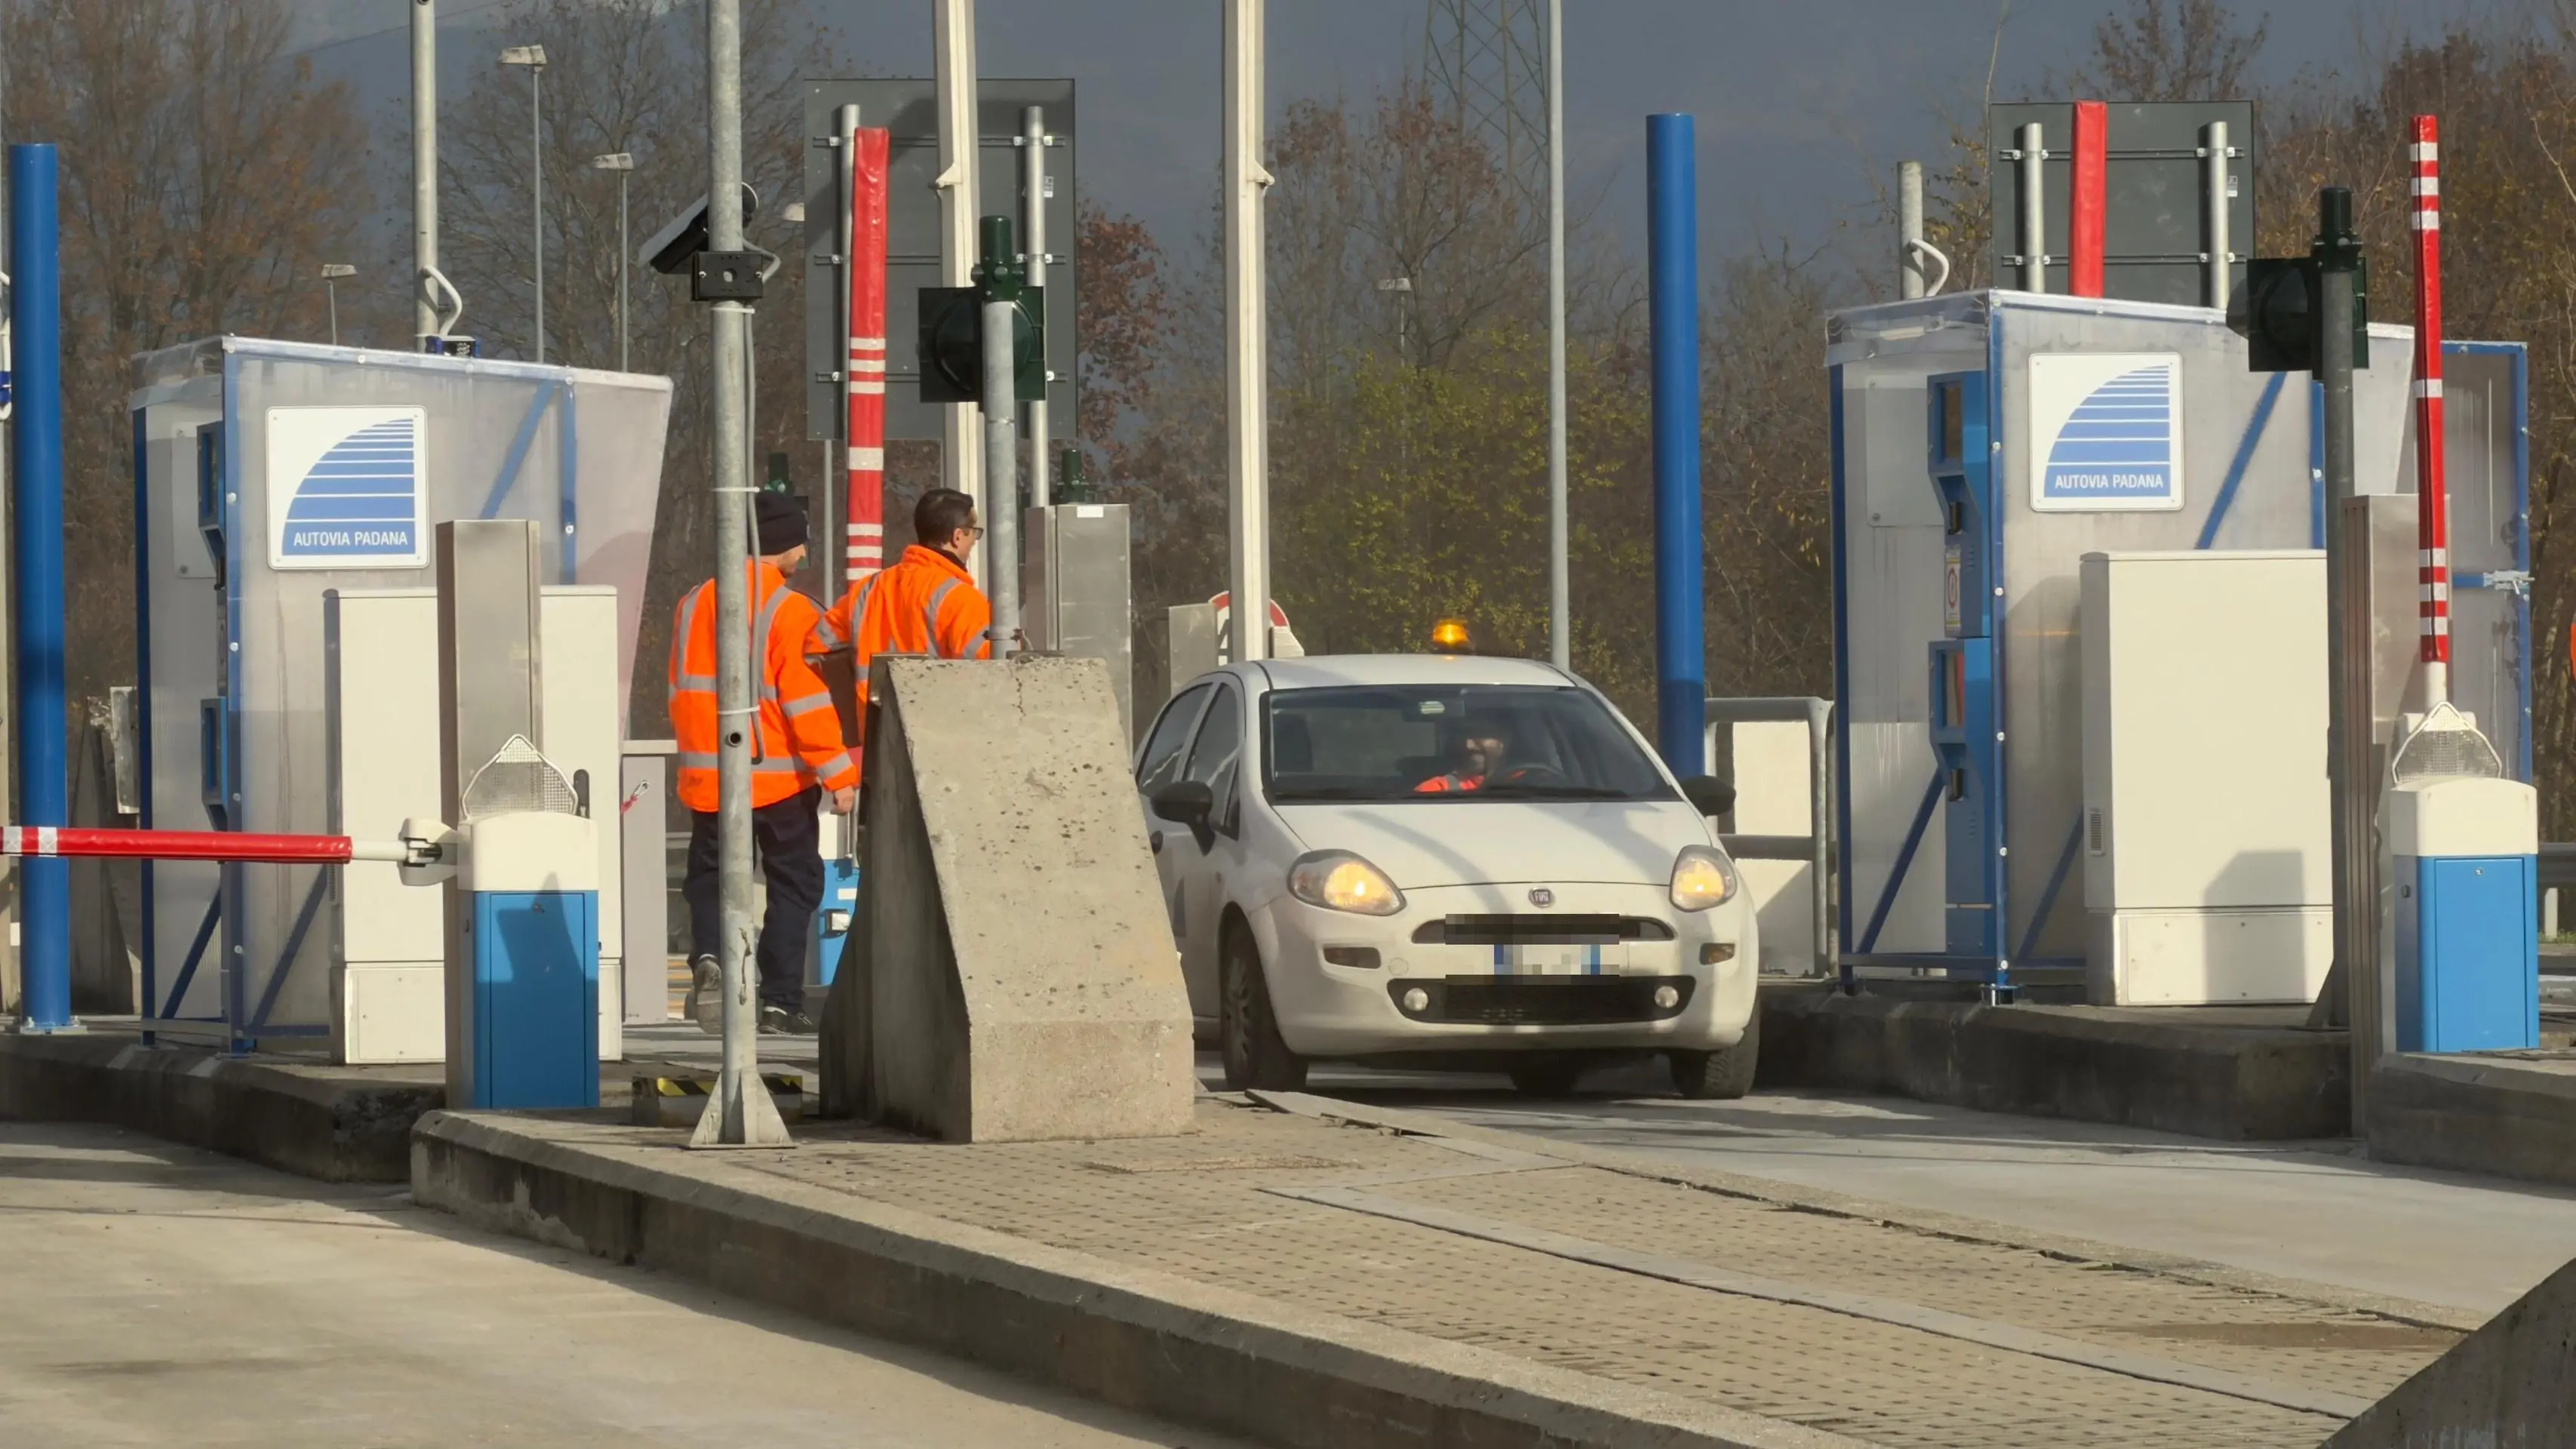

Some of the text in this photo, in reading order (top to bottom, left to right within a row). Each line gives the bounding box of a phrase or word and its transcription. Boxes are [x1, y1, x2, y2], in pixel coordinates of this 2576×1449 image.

[2055, 474, 2164, 489] AUTOVIA PADANA
[294, 531, 408, 546] AUTOVIA PADANA
